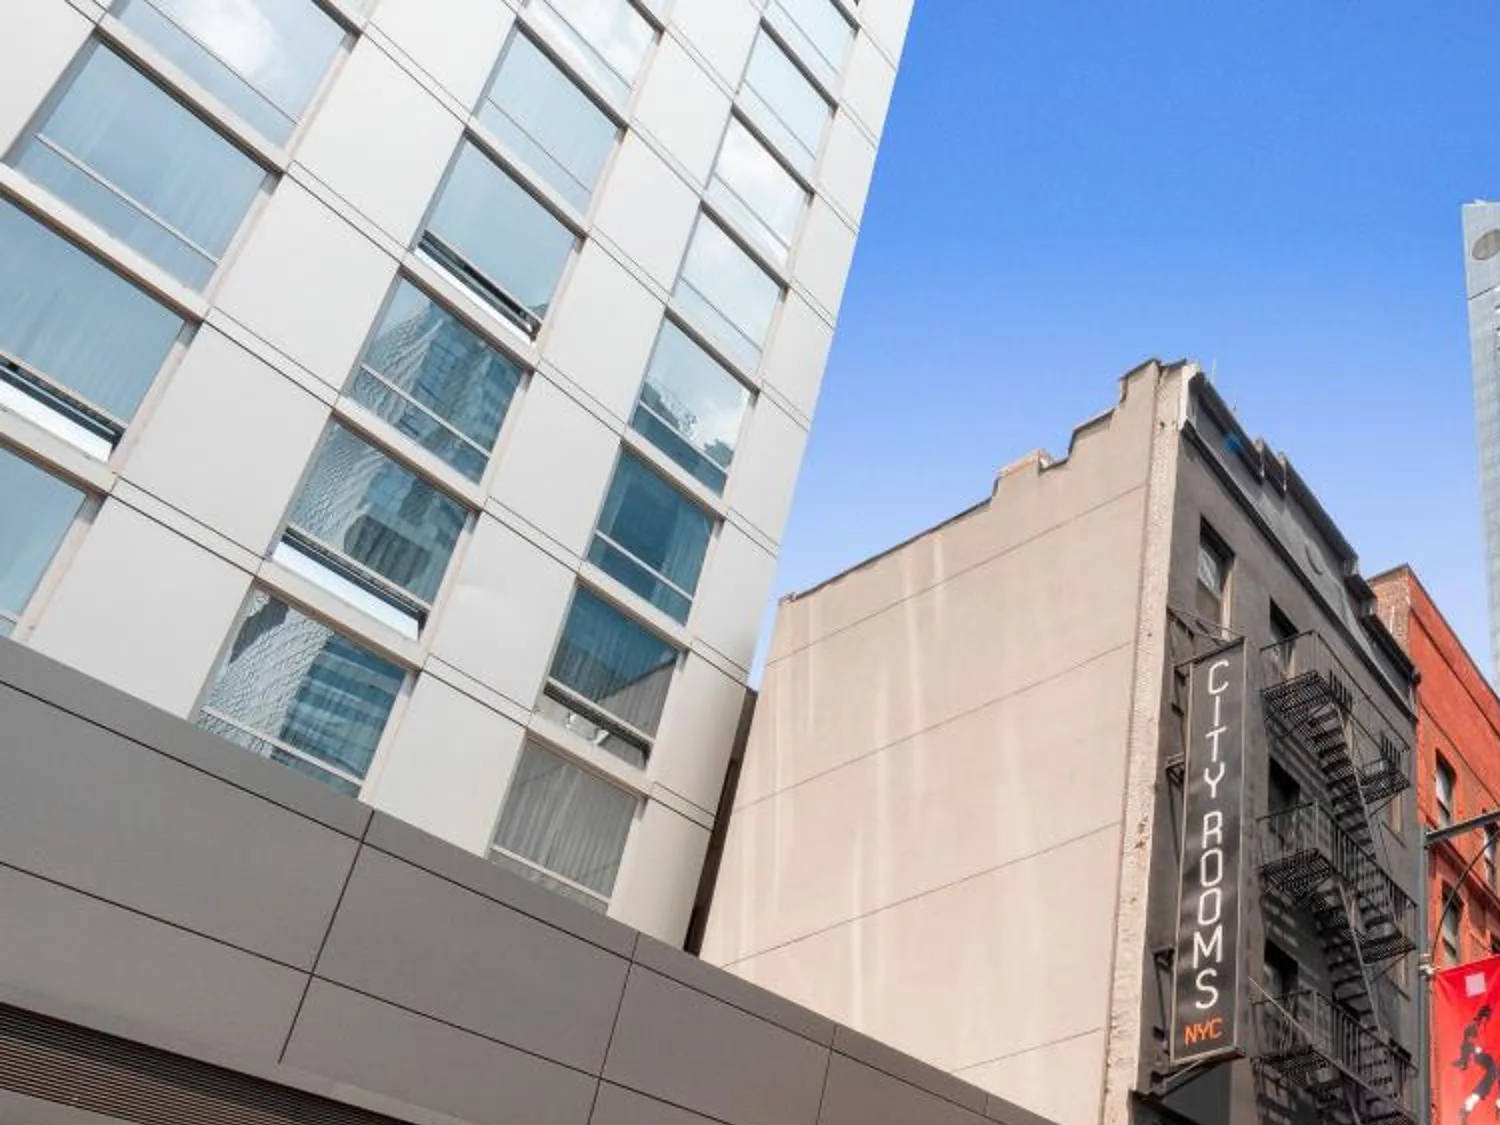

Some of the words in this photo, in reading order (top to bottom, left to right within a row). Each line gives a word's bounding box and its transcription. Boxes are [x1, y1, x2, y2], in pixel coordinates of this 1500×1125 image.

[1203, 660, 1230, 799] CITY
[1192, 810, 1224, 1009] ROOMS
[1184, 1017, 1223, 1046] NYC
